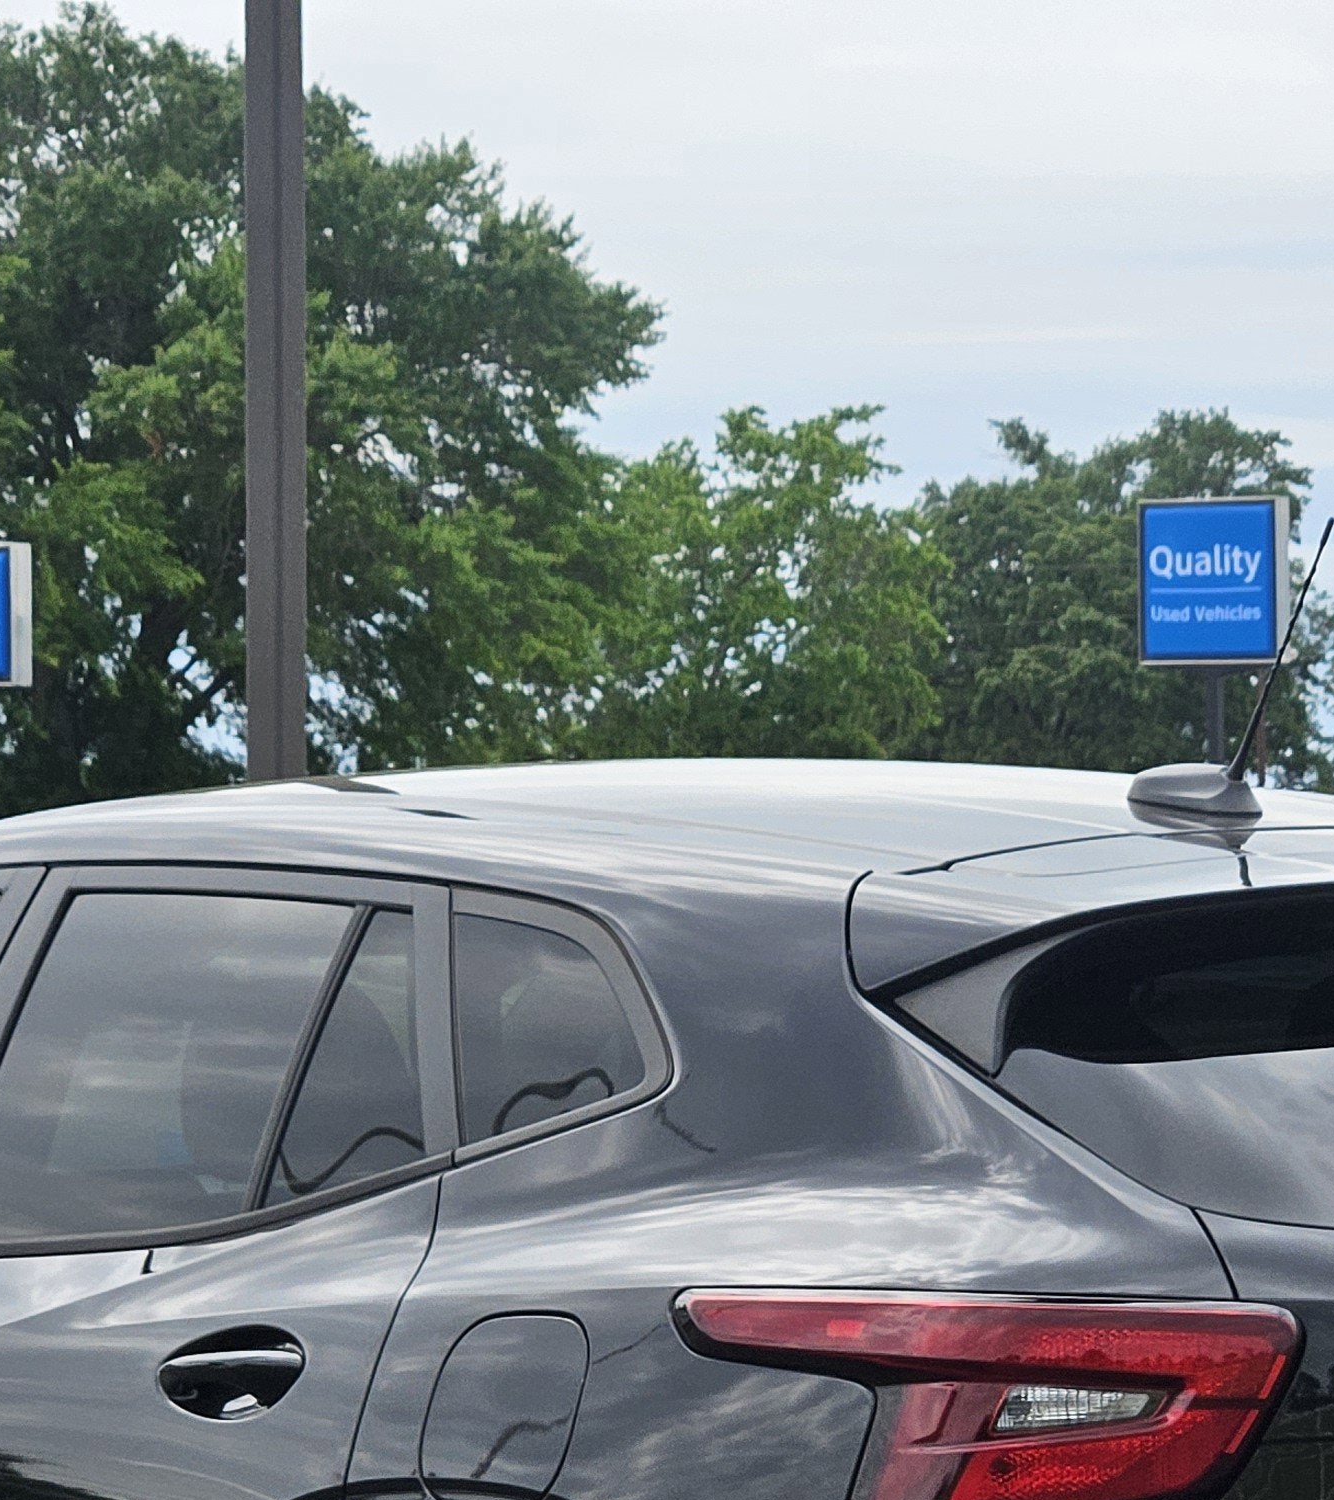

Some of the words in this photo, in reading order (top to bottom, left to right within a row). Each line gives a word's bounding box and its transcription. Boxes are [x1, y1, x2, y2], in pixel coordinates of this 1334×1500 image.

[1149, 543, 1262, 583] Quality
[1150, 605, 1190, 622] Used
[1195, 604, 1261, 622] Vehicles
